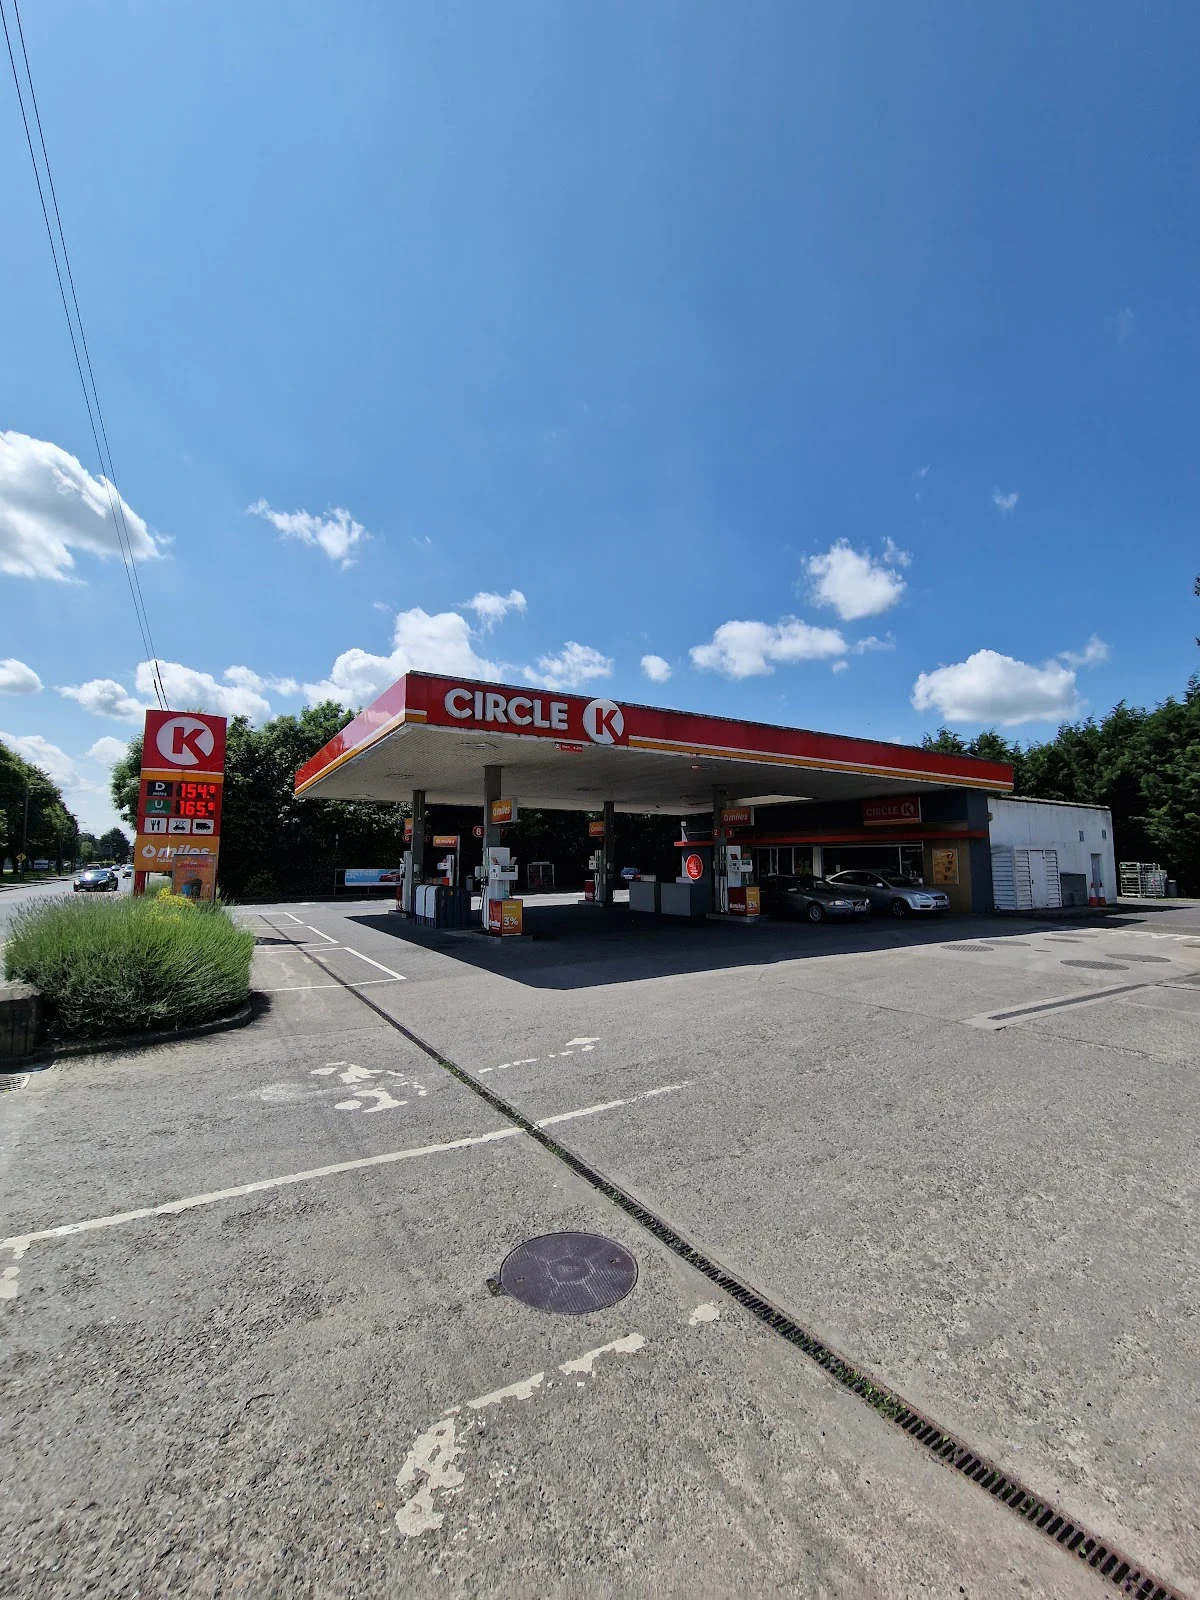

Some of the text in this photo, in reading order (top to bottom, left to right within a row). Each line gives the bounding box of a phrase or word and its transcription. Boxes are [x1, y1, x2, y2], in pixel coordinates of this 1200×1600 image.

[444, 688, 623, 744] CIRCLE K
[170, 725, 209, 764] K
[155, 782, 165, 791] D
[154, 799, 164, 809] U
[866, 802, 914, 816] CIRCLE K
[476, 827, 482, 836] 8
[503, 916, 519, 926] 3%
